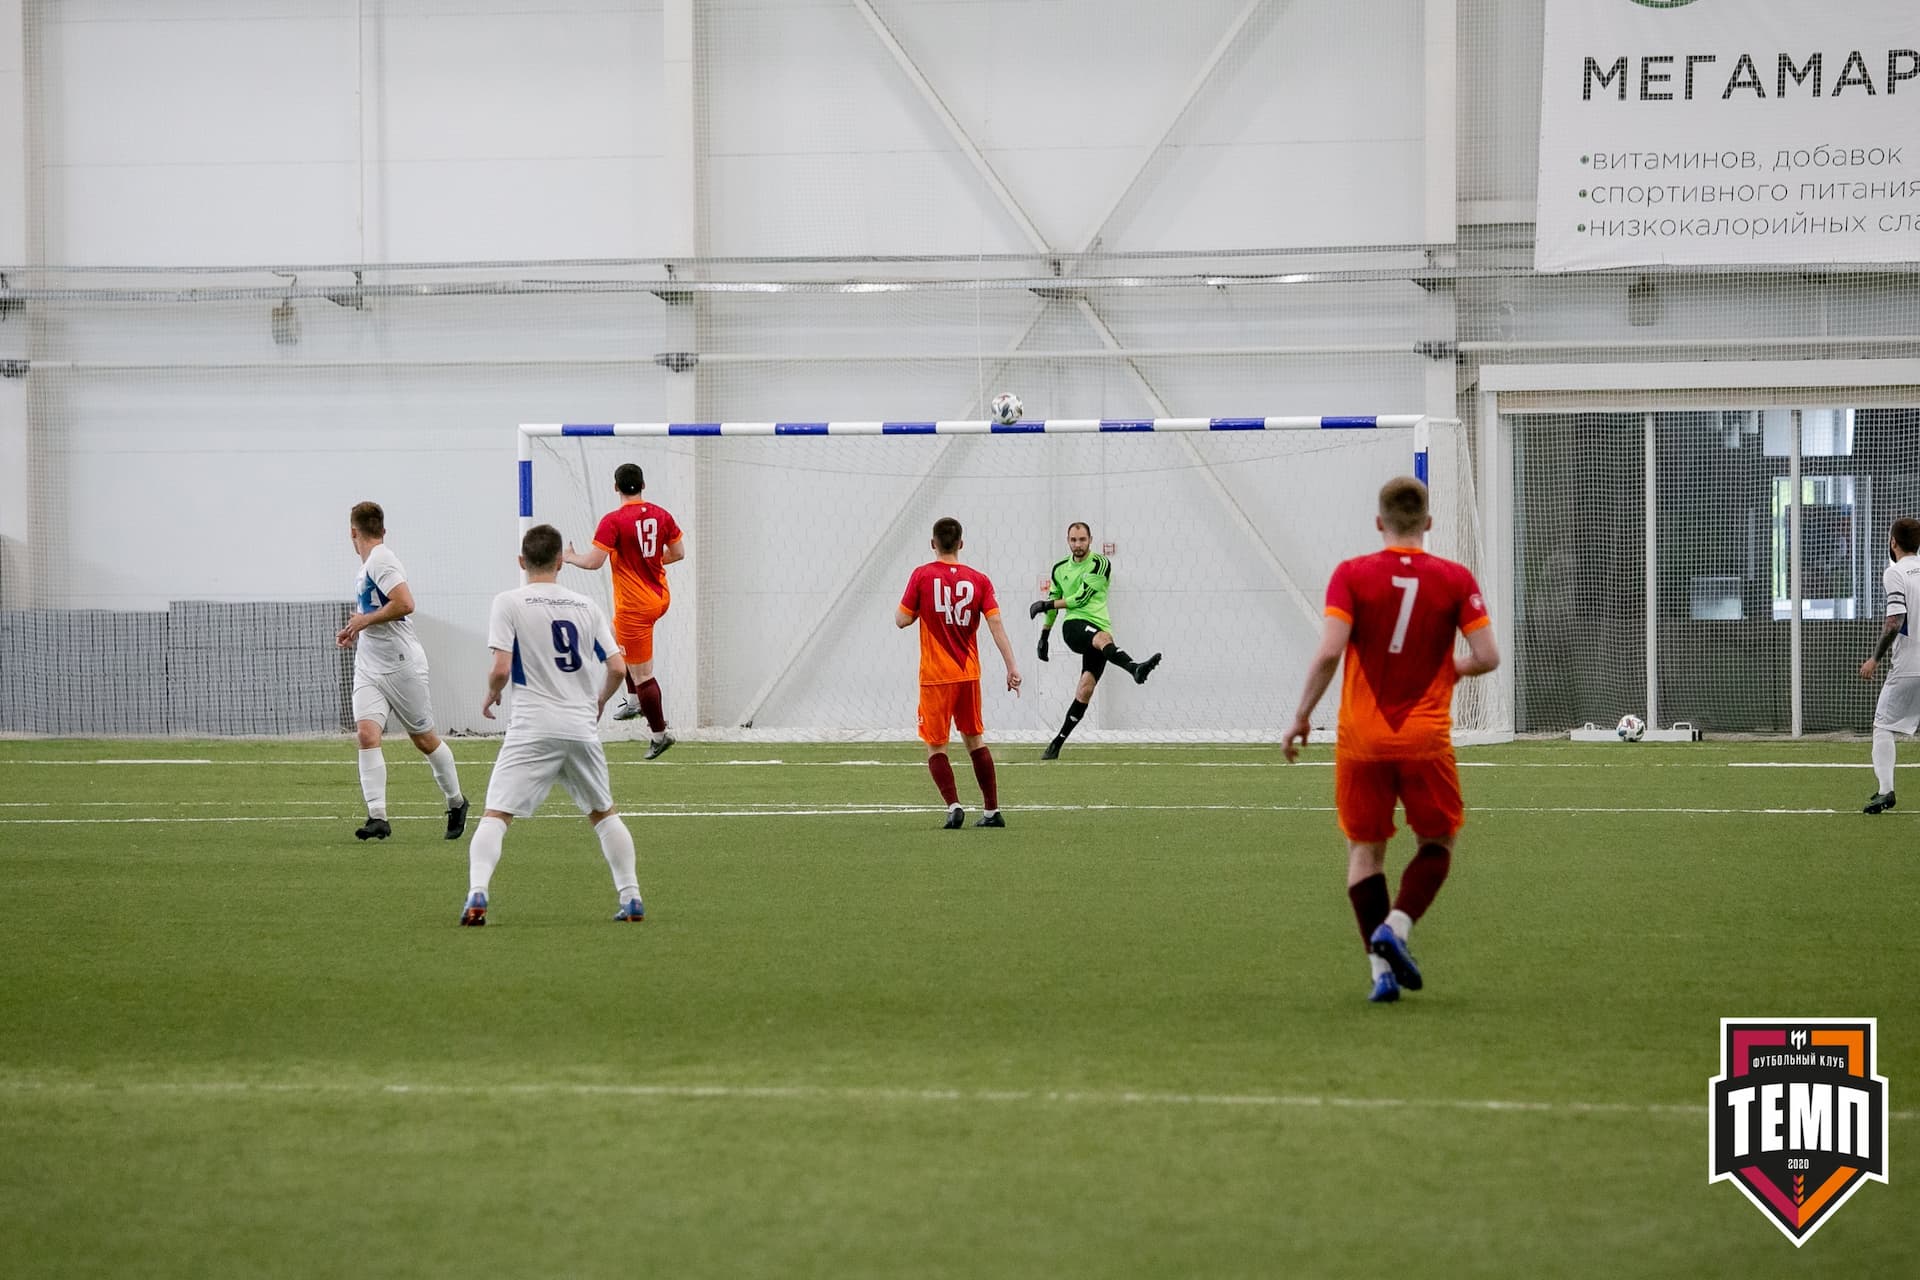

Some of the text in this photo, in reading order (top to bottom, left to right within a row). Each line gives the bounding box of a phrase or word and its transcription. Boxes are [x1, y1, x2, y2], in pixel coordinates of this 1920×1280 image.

[1582, 49, 1920, 101] МЕГАМАР
[1593, 144, 1903, 172] витаминов, добавок
[1591, 180, 1920, 207] спортивного питания
[1590, 211, 1867, 239] низкокалорийных
[635, 518, 658, 558] 13
[934, 578, 974, 627] 42
[1388, 575, 1419, 654] 7
[551, 620, 582, 672] 9
